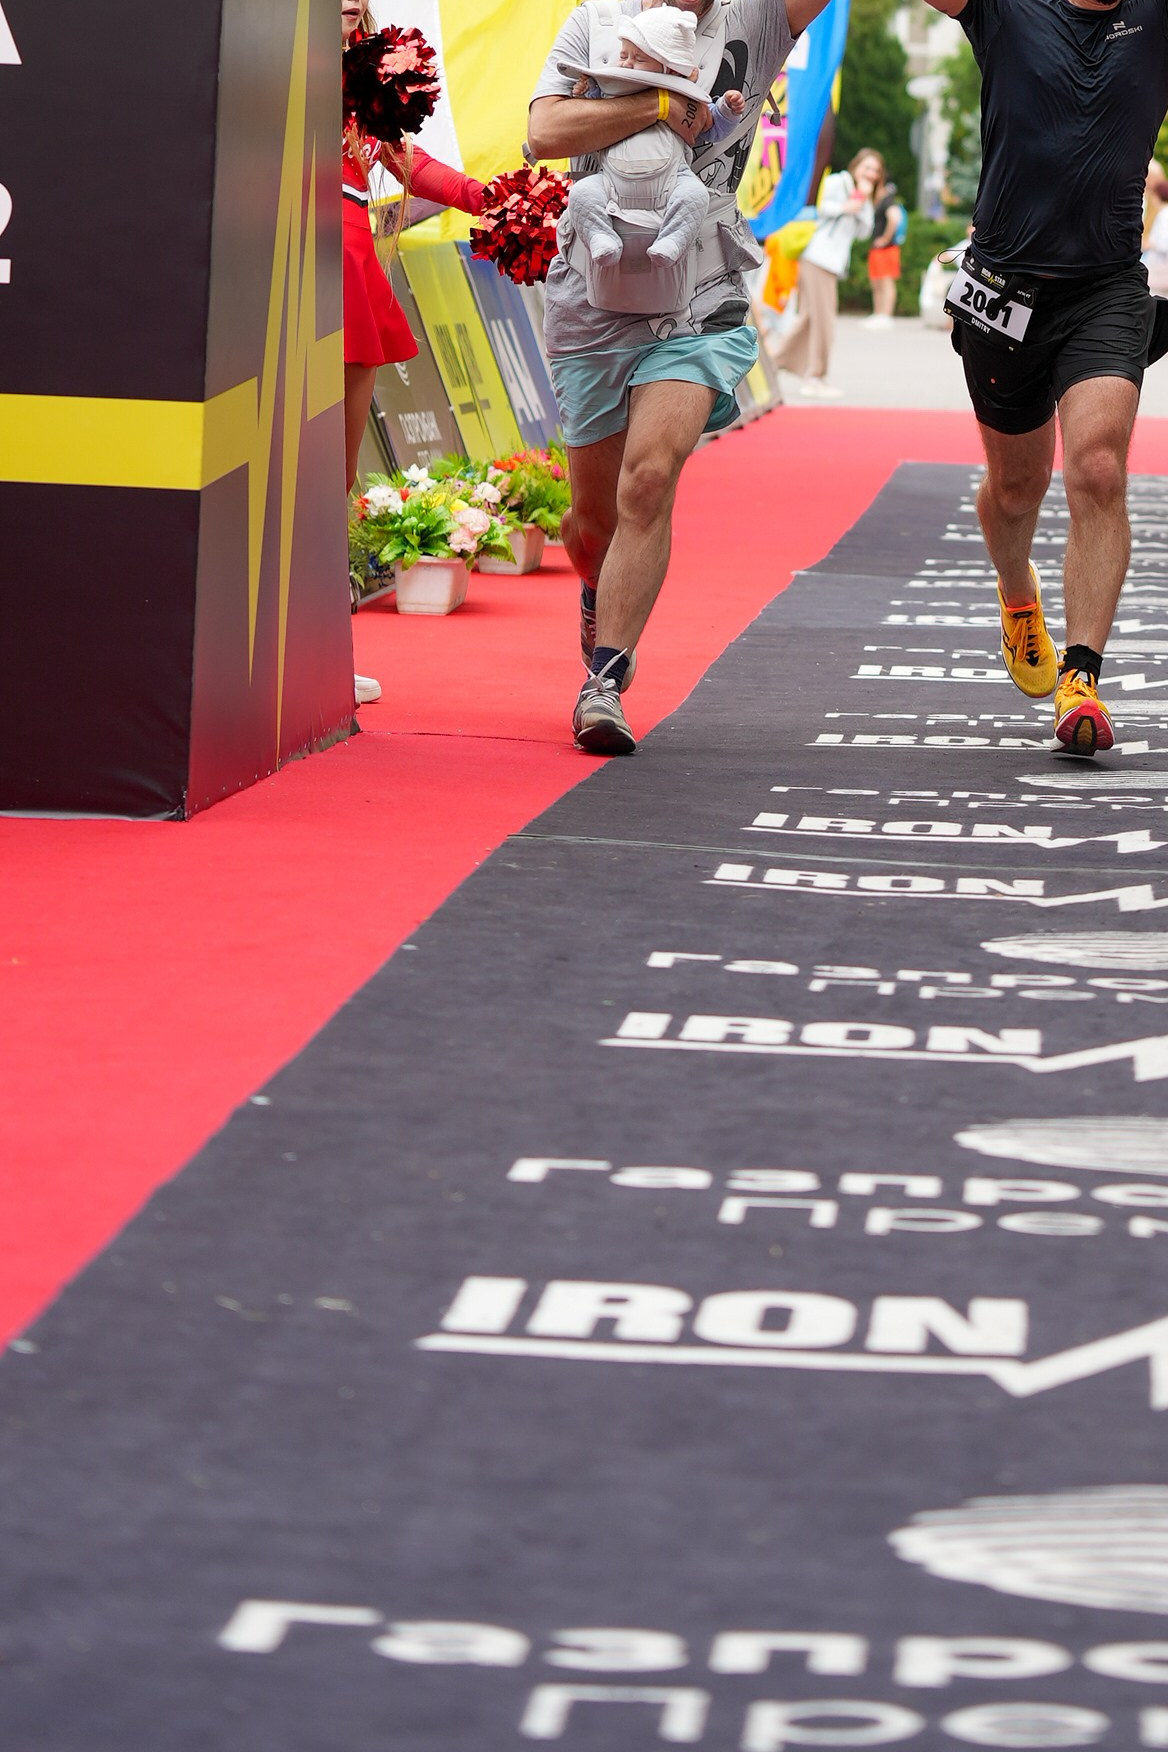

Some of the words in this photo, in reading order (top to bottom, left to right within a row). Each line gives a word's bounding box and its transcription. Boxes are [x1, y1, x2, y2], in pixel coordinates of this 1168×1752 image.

[970, 317, 991, 335] DMITRY
[752, 812, 1053, 838] IRON
[714, 863, 1045, 897] IRON
[616, 1012, 1042, 1055] IRON
[440, 1276, 1029, 1356] IRON
